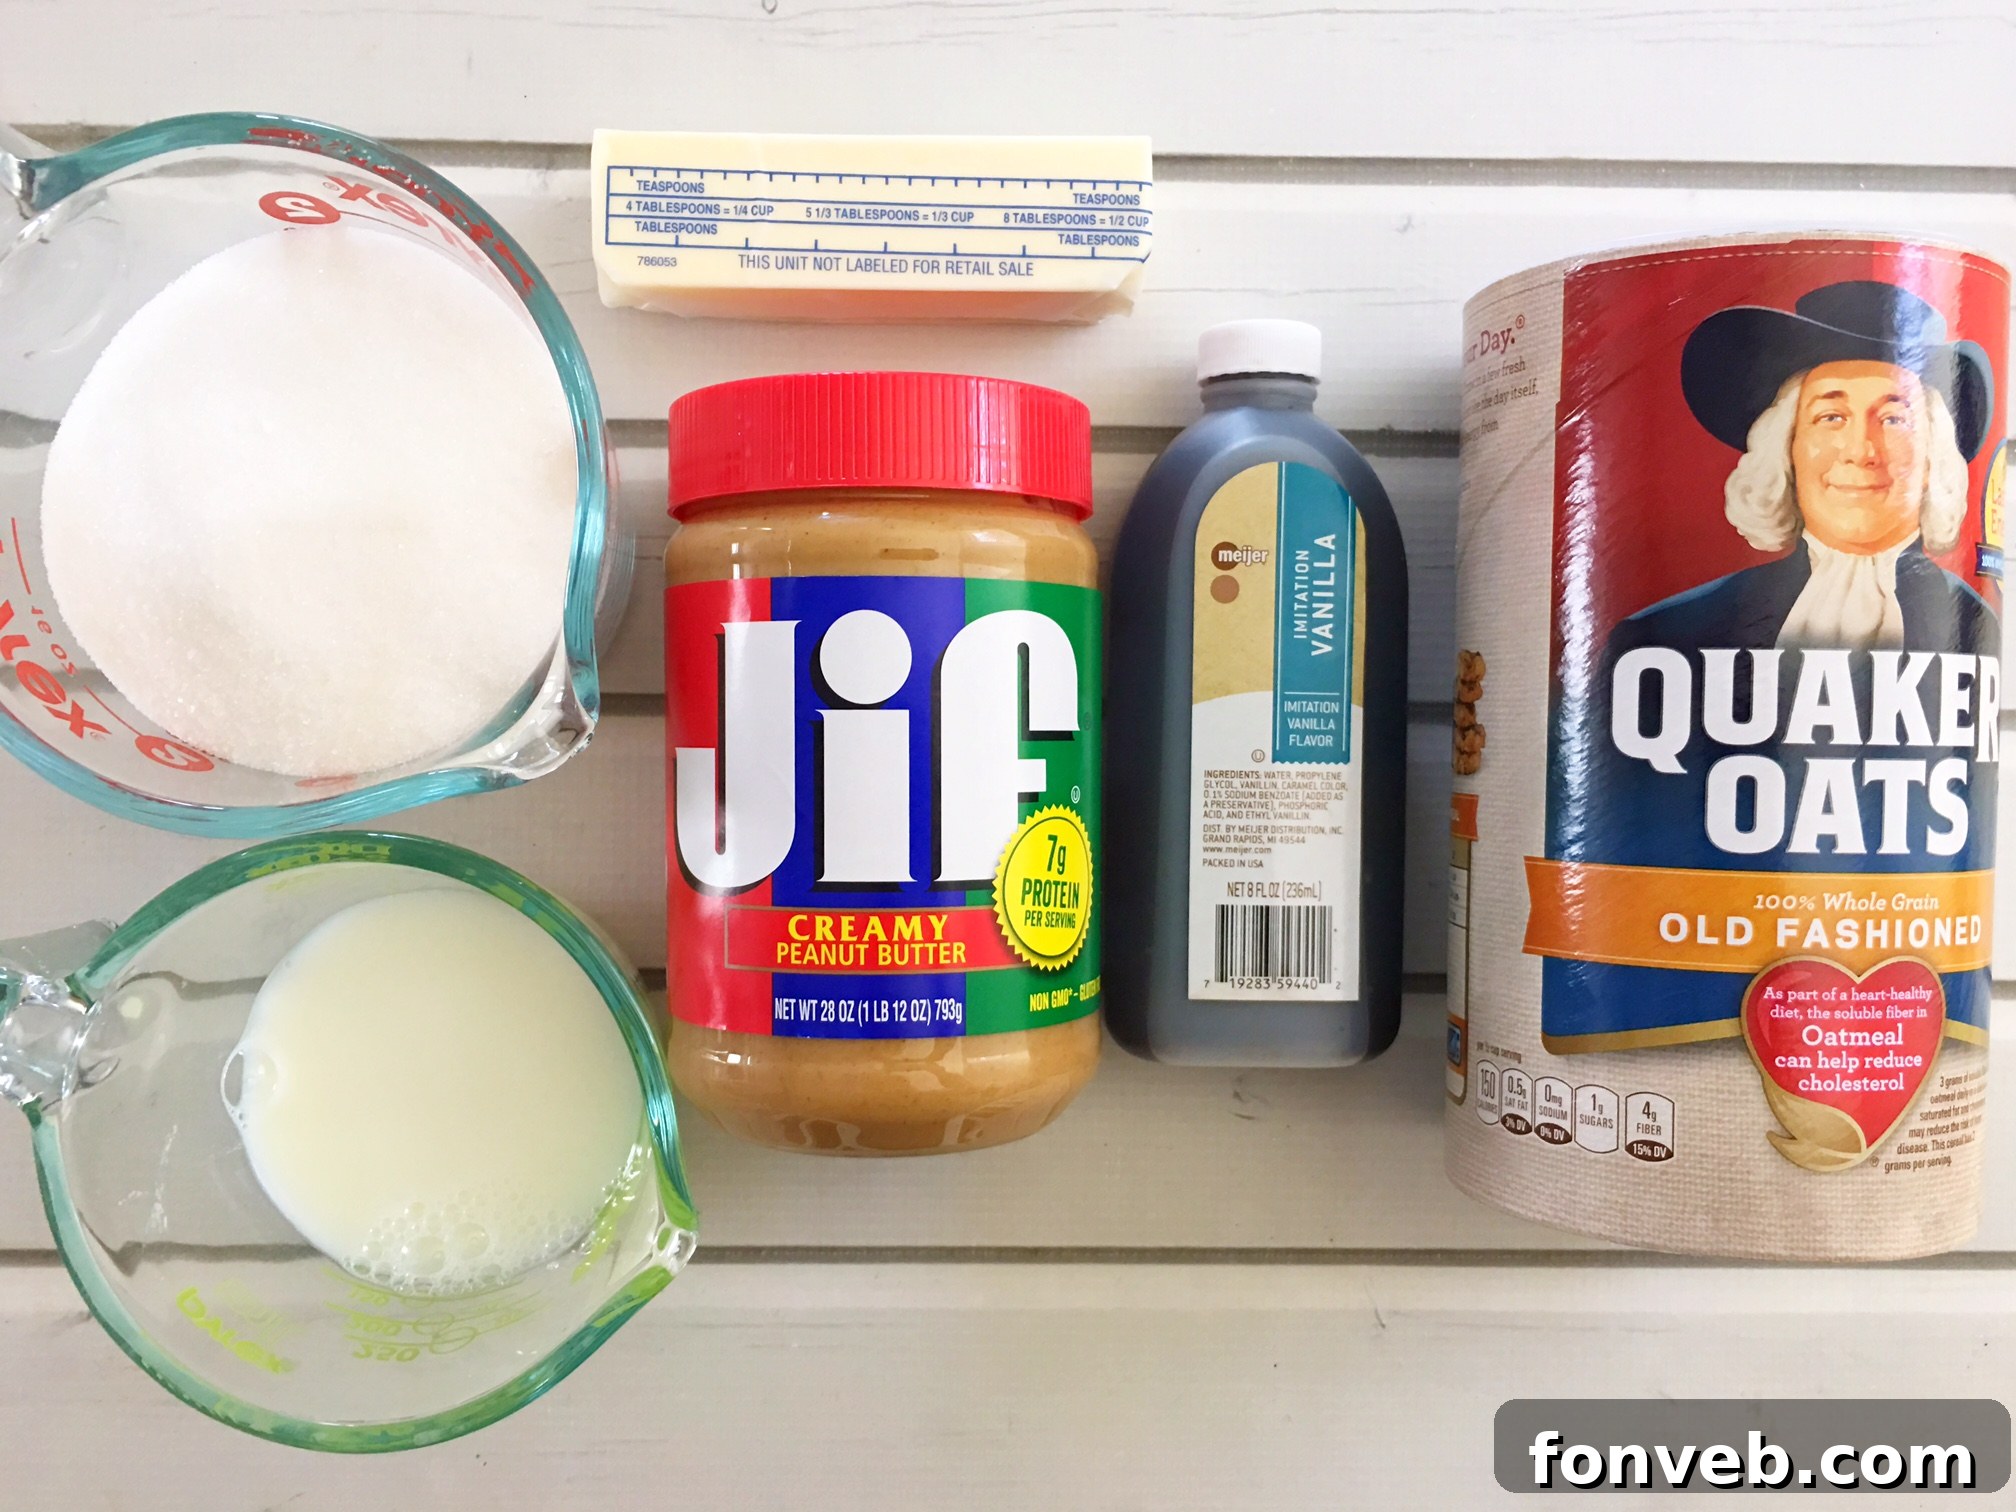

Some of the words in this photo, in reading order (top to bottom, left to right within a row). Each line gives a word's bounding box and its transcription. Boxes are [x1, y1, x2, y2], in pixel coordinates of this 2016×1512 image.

[637, 180, 705, 194] TEASPOONS
[1073, 193, 1141, 206] TEASPOONS
[626, 201, 632, 212] 4
[636, 201, 721, 215] TABLESPOONS
[733, 205, 748, 216] 1/4
[751, 205, 775, 216] CUP
[806, 207, 812, 218] 5
[815, 208, 831, 219] 1/3
[835, 208, 919, 222] TABLESPOONS
[932, 211, 948, 222] 1/3
[951, 212, 974, 223] CUP
[635, 221, 718, 236] TABLESPOONS
[1003, 213, 1010, 223] 8
[1013, 213, 1096, 226] TABLESPOONS
[1109, 215, 1125, 226] 1/2
[1127, 215, 1149, 228] CUP
[1058, 234, 1140, 247] TABLESPOONS
[637, 256, 678, 268] 786053
[738, 254, 770, 270] THIS
[775, 256, 808, 271] UNIT
[813, 257, 842, 272] NOT
[847, 258, 908, 274] LABELED
[913, 260, 940, 275] FOR
[945, 261, 994, 276] RETAIL
[999, 262, 1034, 277] SALE
[1502, 356, 1527, 377] fresh
[1218, 546, 1269, 566] meijer
[1294, 550, 1310, 639] IMITATION
[1311, 534, 1336, 656] VANILLA
[1284, 701, 1340, 714] IMITATION
[1611, 646, 2000, 774] QUAKER
[1287, 718, 1336, 730] VANILLA
[1289, 734, 1333, 747] FLAVOR
[674, 609, 1080, 892] Jif
[1204, 770, 1261, 780] INGREDIENTS:
[1295, 771, 1342, 781] PROPYLENE
[1281, 781, 1318, 790] CARAMEL
[1320, 782, 1349, 792] COLOR,
[1224, 790, 1257, 800] SODIUM
[1258, 790, 1299, 800] BENZOATE
[1333, 791, 1344, 801] AS
[1203, 800, 1209, 809] A
[1278, 801, 1329, 811] PHOSPHORIC
[1705, 754, 1969, 857] OATS
[1202, 810, 1224, 820] ACID,
[1226, 810, 1243, 819] AND
[1245, 811, 1271, 820] ETHYL
[1225, 824, 1236, 834] BY
[1238, 825, 1268, 834] MEIJER
[1202, 834, 1231, 844] GRAND
[1233, 834, 1265, 845] RAPIDS,
[1267, 835, 1276, 844] MI
[1047, 834, 1067, 876] 7g
[1202, 858, 1235, 868] PACKED
[1237, 859, 1246, 868] IN
[1248, 859, 1264, 868] USA
[1021, 878, 1080, 910] PROTEIN
[1227, 881, 1245, 898] NET
[1247, 882, 1254, 898] 8
[1256, 882, 1267, 898] FL
[1269, 882, 1280, 898] OZ
[1282, 880, 1322, 902] (236mL)
[1754, 894, 1816, 911] 100%
[1823, 891, 1886, 912] Whole
[1891, 892, 1939, 911] Grain
[788, 914, 948, 942] CREAMY
[1024, 911, 1043, 928] PER
[1045, 911, 1076, 929] SERVING
[1659, 912, 1753, 946] OLD
[1776, 914, 1982, 949] FASHIONED
[776, 942, 869, 966] PEANUT
[878, 942, 966, 966] BUTTER
[1204, 980, 1210, 988] 7
[1229, 978, 1271, 989] 19283
[1277, 978, 1318, 989] 59440
[1335, 981, 1341, 990] 2
[1029, 991, 1049, 1012] NON
[1763, 986, 1783, 999] As
[1788, 988, 1819, 1003] part
[1822, 987, 1838, 1001] of
[1839, 991, 1848, 1001] a
[1851, 985, 1933, 1002] heart-healthy
[775, 997, 796, 1020] NET
[799, 998, 818, 1021] WT
[821, 999, 835, 1022] 28
[839, 1000, 855, 1022] OZ
[858, 1000, 869, 1027] (1
[874, 1001, 889, 1022] LB
[893, 1000, 907, 1022] 12
[910, 999, 931, 1026] OZ)
[935, 998, 962, 1024] 793g
[1770, 1004, 1803, 1020] diet,
[1807, 1006, 1830, 1019] the
[1834, 1006, 1883, 1019] soluble
[1886, 1005, 1914, 1019] fiber
[1916, 1006, 1928, 1018] in
[1802, 1023, 1903, 1046] Oatmeal
[1775, 1056, 1812, 1068] can
[1817, 1051, 1859, 1073] help
[1863, 1050, 1922, 1069] reduce
[1481, 1068, 1496, 1099] 150
[1507, 1075, 1527, 1099] 0.5g
[1798, 1073, 1905, 1092] cholesterol
[1504, 1096, 1515, 1108] SAT
[1517, 1099, 1528, 1111] FAT
[1538, 1105, 1568, 1121] SODIUM
[1642, 1101, 1657, 1123] 4g
[1919, 1105, 1952, 1121] saturated
[1516, 1119, 1527, 1131] DV
[1579, 1113, 1614, 1129] SUGARS
[1636, 1122, 1662, 1136] FIBER
[1553, 1128, 1565, 1141] DV
[1908, 1127, 1925, 1139] may
[1926, 1124, 1950, 1136] reduce
[1632, 1143, 1652, 1156] 15%
[1653, 1145, 1667, 1158] DV
[1931, 1138, 1946, 1151] This
[1884, 1159, 1911, 1174] grams
[1912, 1158, 1925, 1172] per
